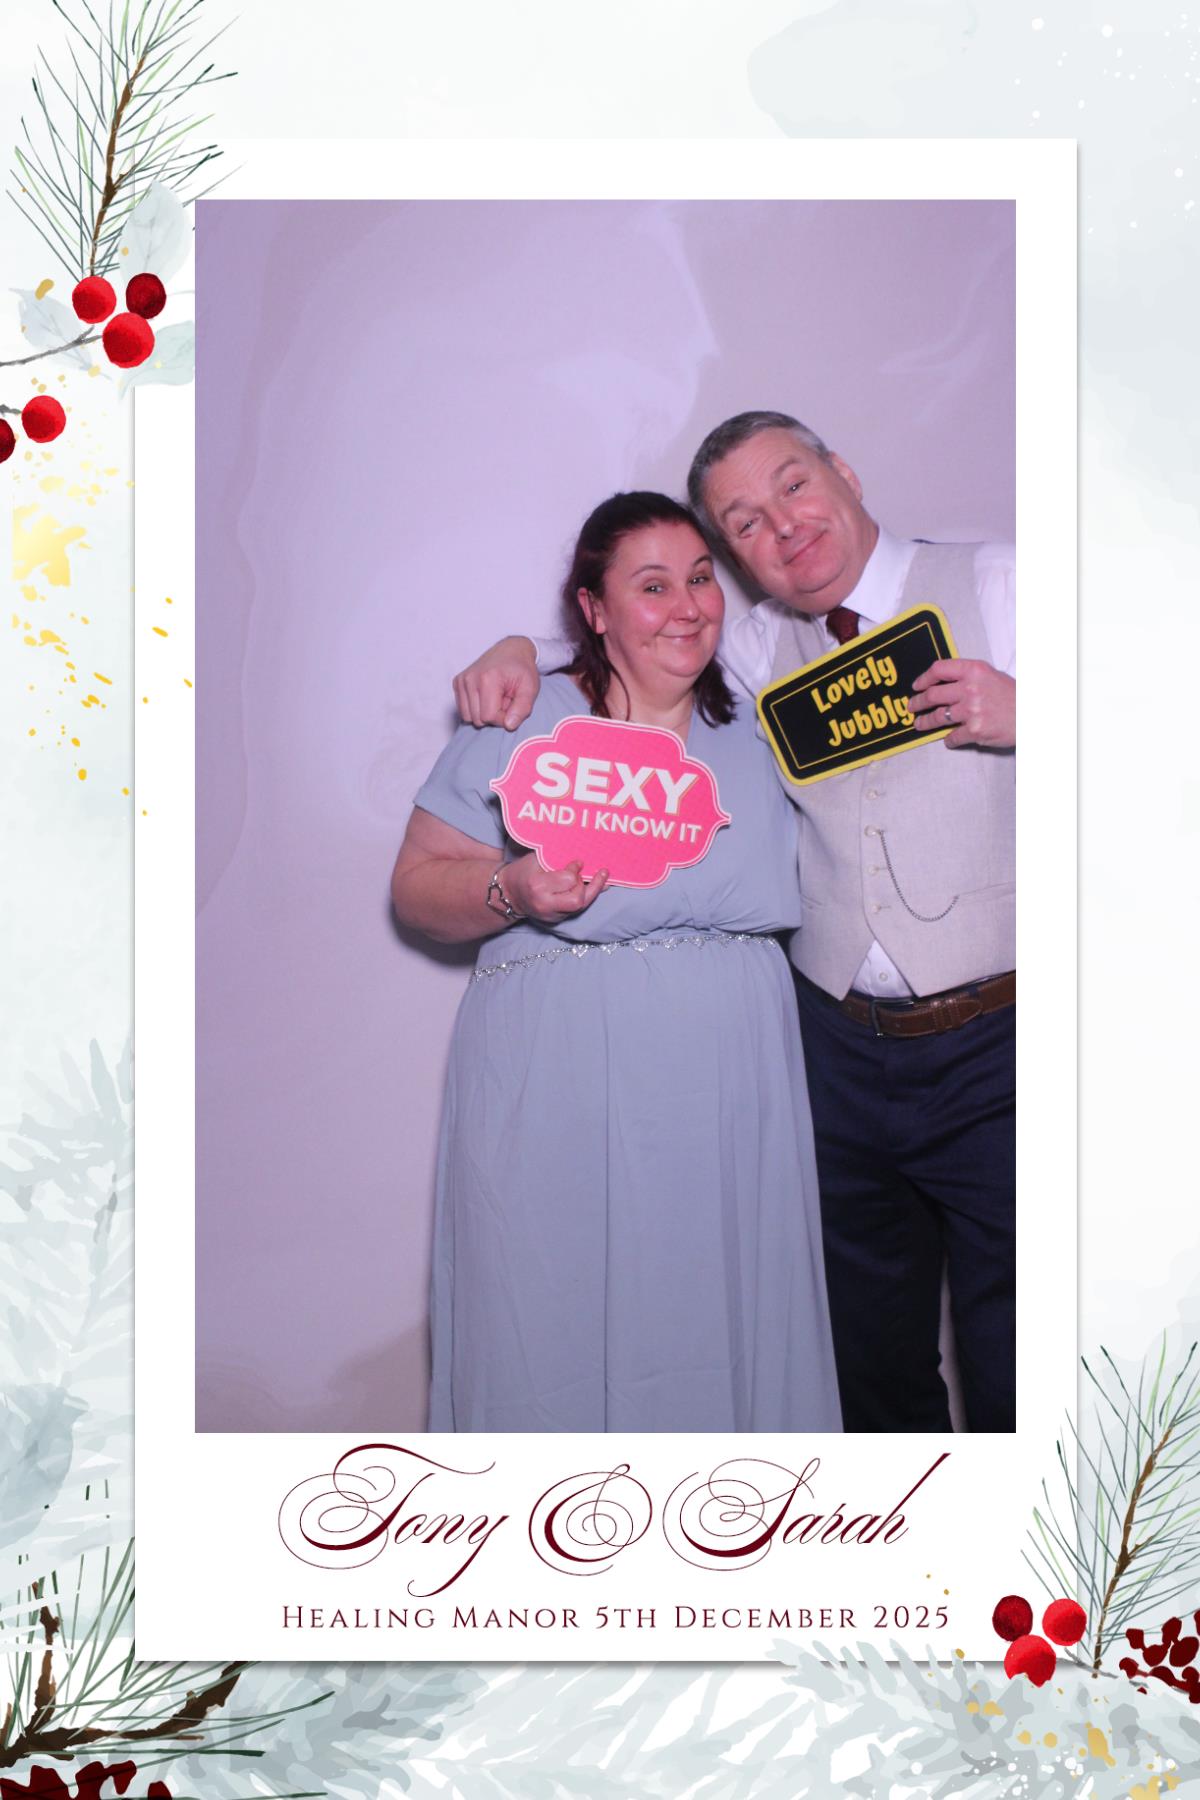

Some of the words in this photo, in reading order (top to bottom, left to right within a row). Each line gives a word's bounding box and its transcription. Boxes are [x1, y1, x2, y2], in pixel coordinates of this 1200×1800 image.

[810, 655, 898, 714] Lovely
[828, 693, 915, 747] Jubbly
[531, 751, 699, 816] SEXY
[517, 800, 576, 825] AND
[580, 808, 589, 829] I
[594, 811, 676, 841] KNOW
[679, 822, 702, 844] IT
